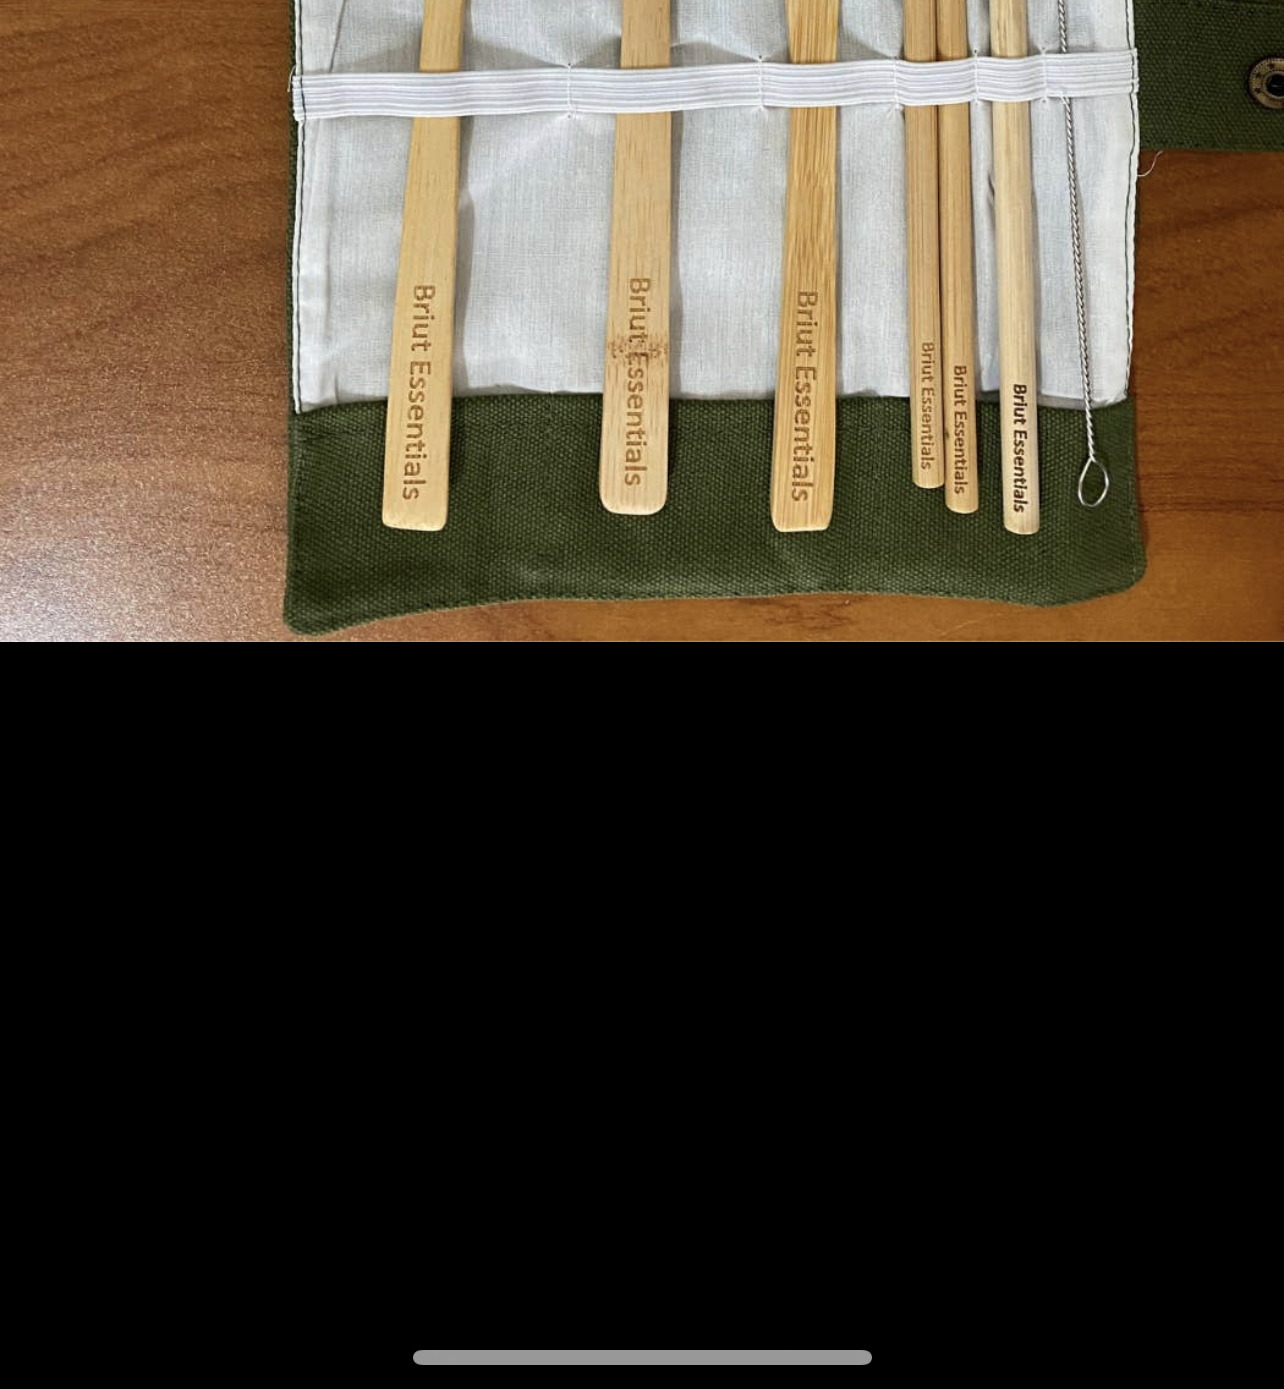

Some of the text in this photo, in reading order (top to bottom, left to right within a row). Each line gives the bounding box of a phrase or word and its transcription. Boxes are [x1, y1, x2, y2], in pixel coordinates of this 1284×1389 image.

[402, 284, 436, 500] Briut Essentials
[624, 277, 651, 486] Briut Essentials
[791, 290, 818, 502] Briut Essentials
[920, 341, 936, 471] Briut Essentials
[953, 365, 969, 495] Briut Essentials
[1012, 383, 1028, 513] Briut Essentials
